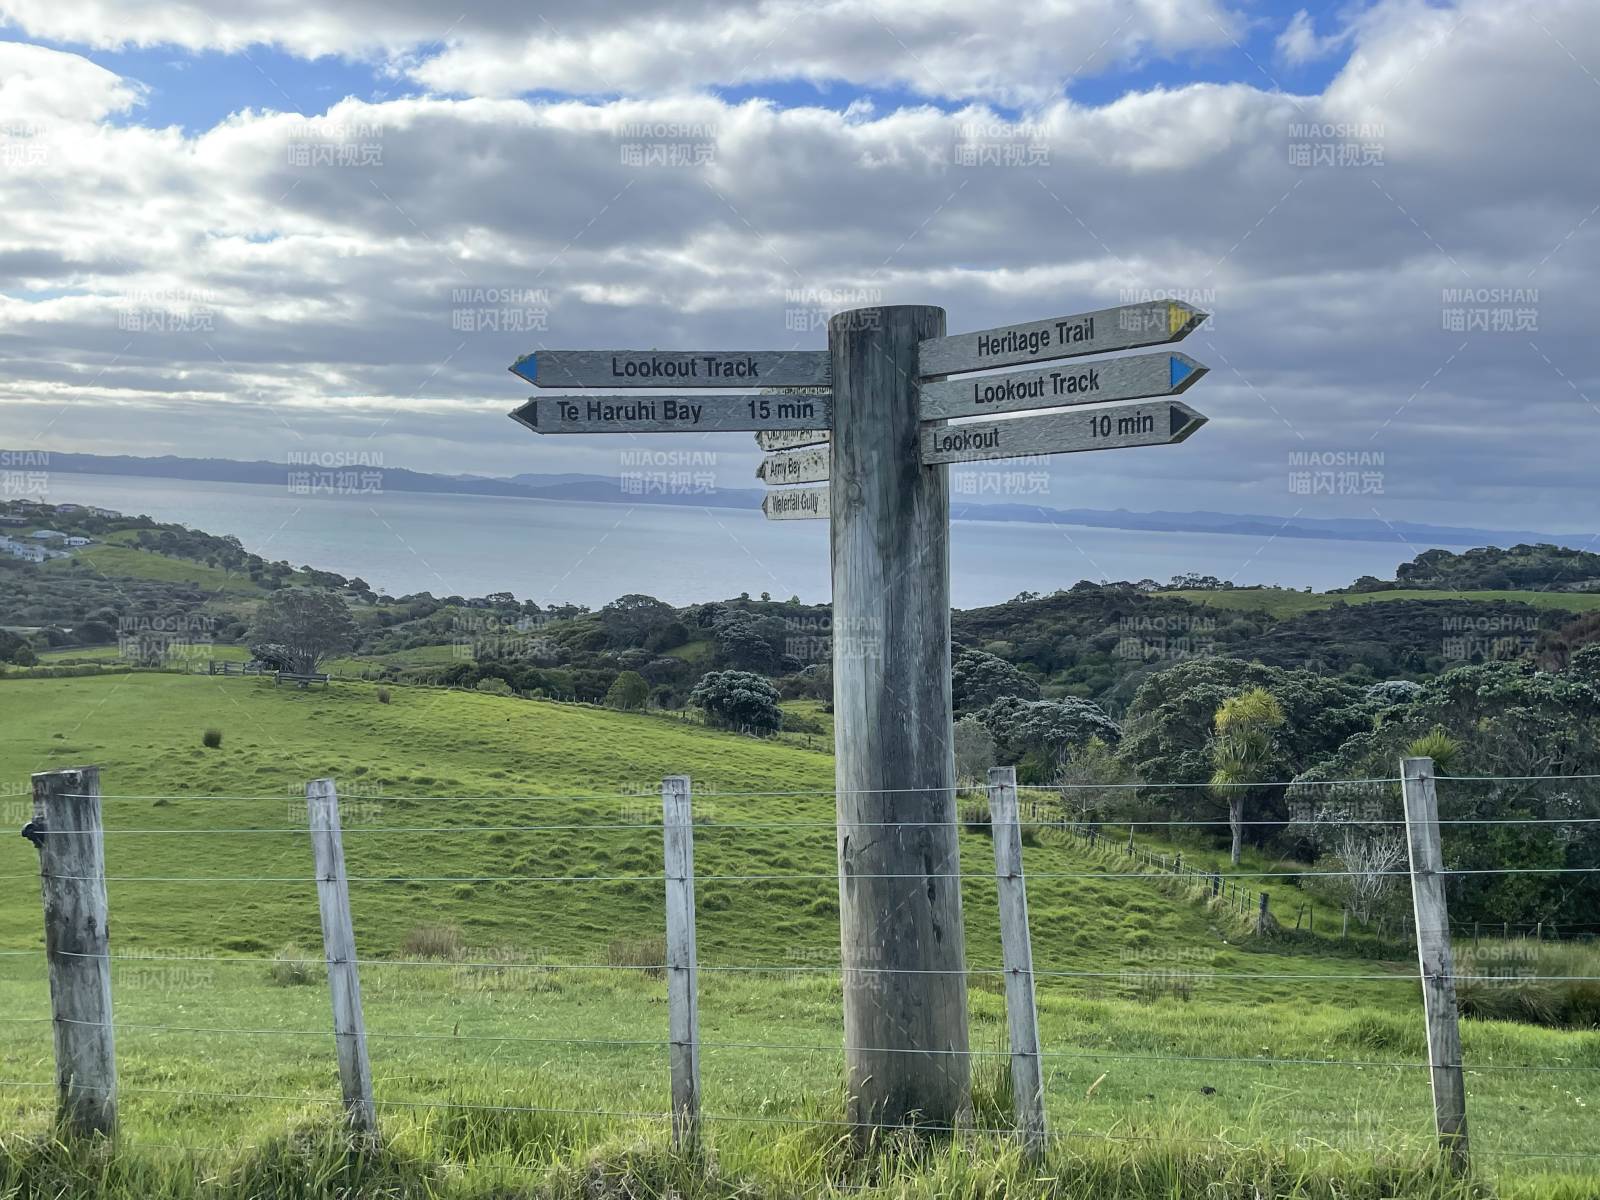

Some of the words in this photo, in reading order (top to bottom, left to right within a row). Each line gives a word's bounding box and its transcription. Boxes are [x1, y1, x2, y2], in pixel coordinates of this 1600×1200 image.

[978, 330, 1050, 357] Heritage
[1055, 318, 1095, 344] Trail
[612, 357, 698, 378] Lookout
[704, 357, 760, 377] Track
[975, 376, 1045, 404] Lookout
[1050, 369, 1100, 395] Track
[557, 401, 579, 420] Te
[587, 401, 656, 420] Haruhi
[663, 401, 703, 424] Bay
[748, 400, 771, 419] 15
[778, 400, 814, 419] min
[933, 428, 1000, 451] Lookout
[1090, 416, 1111, 437] 10
[1118, 411, 1154, 436] min
[770, 460, 787, 481] Army
[788, 457, 801, 478] Bay
[772, 492, 800, 513] Waterfall
[800, 491, 819, 514] Gully
